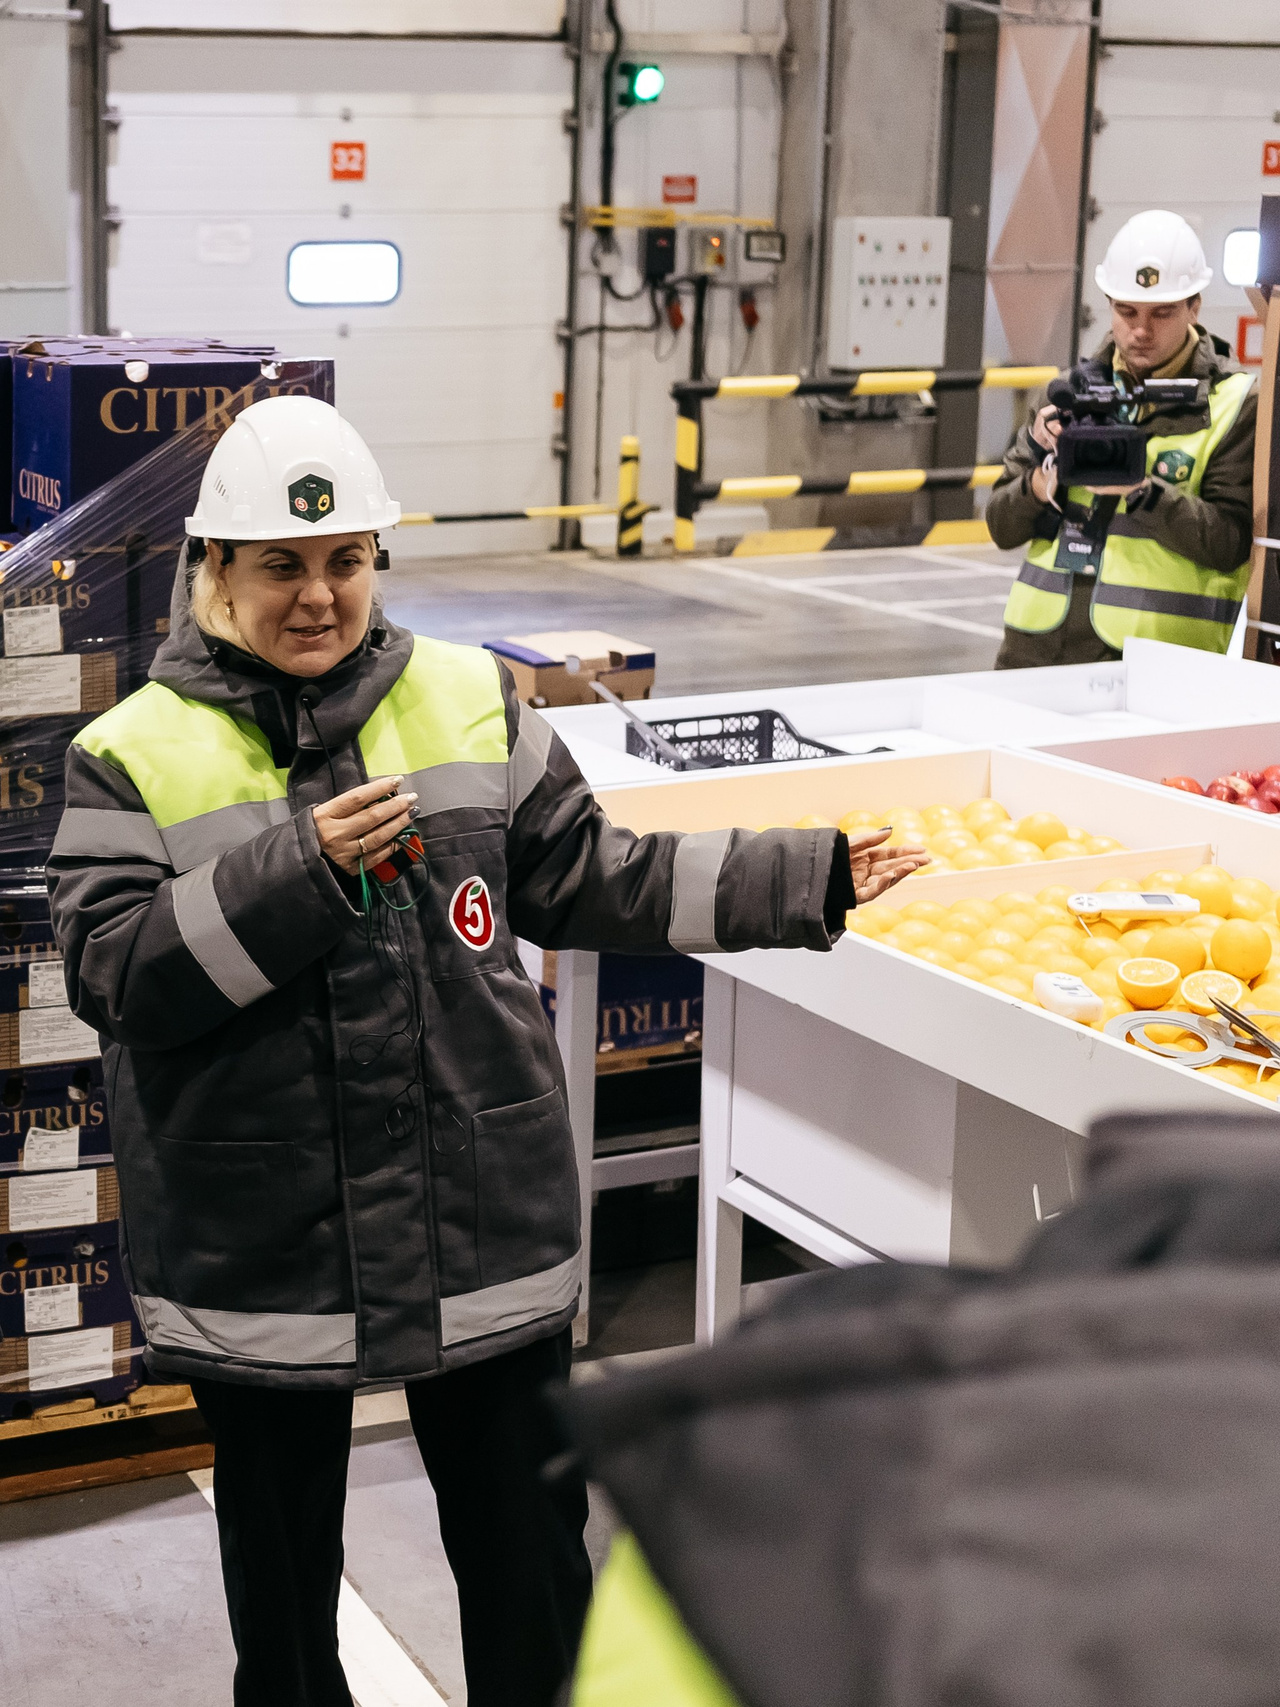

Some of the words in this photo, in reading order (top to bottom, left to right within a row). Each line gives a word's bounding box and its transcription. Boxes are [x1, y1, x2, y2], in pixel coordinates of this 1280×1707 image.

[332, 147, 363, 172] 32
[1267, 146, 1280, 170] 3
[99, 384, 311, 434] CITR
[19, 467, 62, 511] CITRUS
